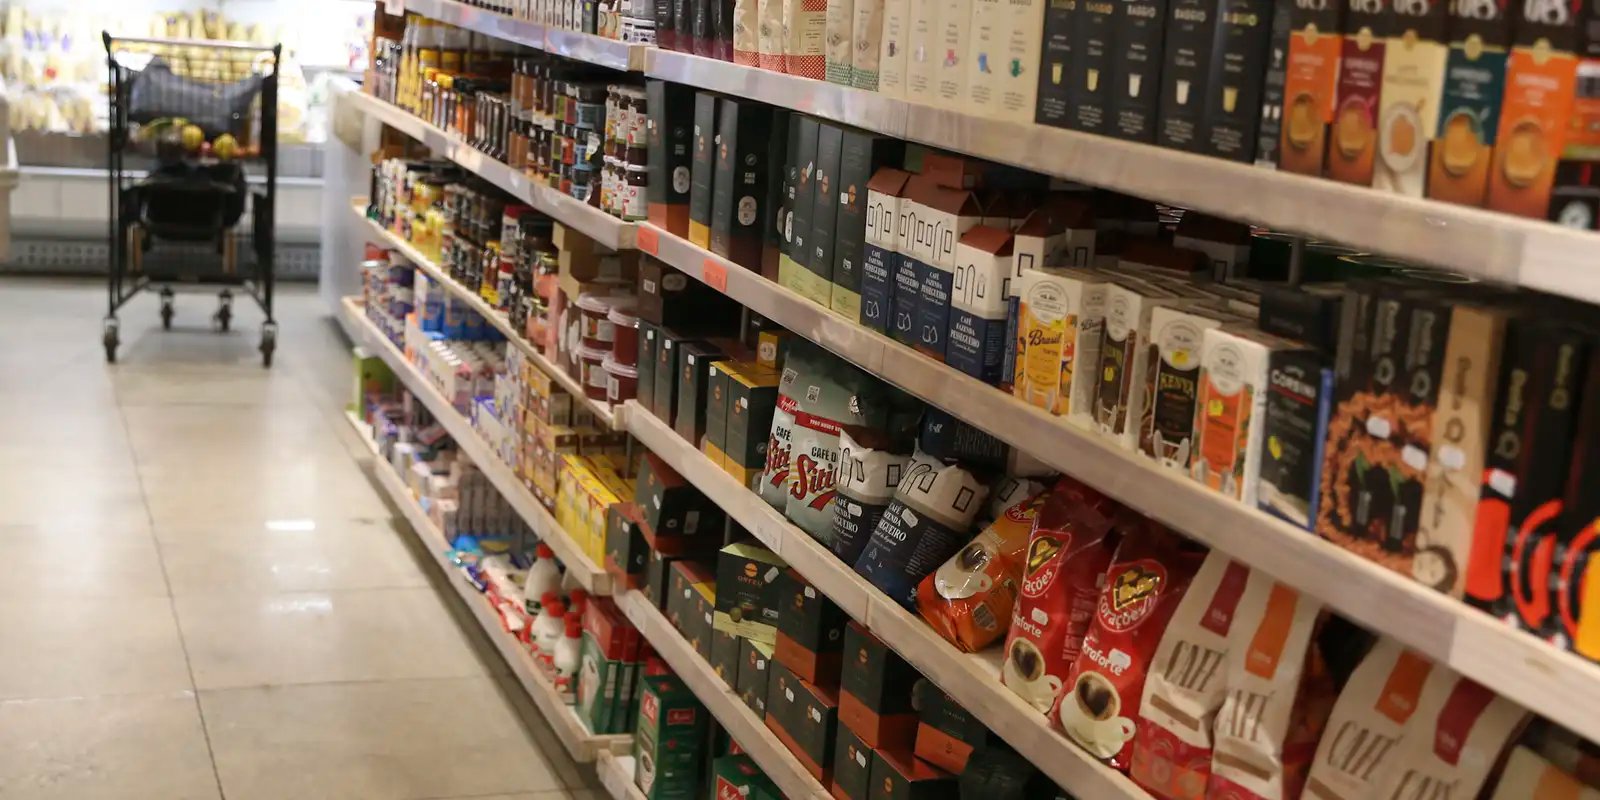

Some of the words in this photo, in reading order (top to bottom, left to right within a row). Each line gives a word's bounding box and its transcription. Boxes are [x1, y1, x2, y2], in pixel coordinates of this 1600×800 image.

[1028, 329, 1062, 346] Brasil
[776, 425, 792, 441] CAFÉ
[811, 446, 830, 462] CAFÉ
[790, 453, 838, 501] Siti
